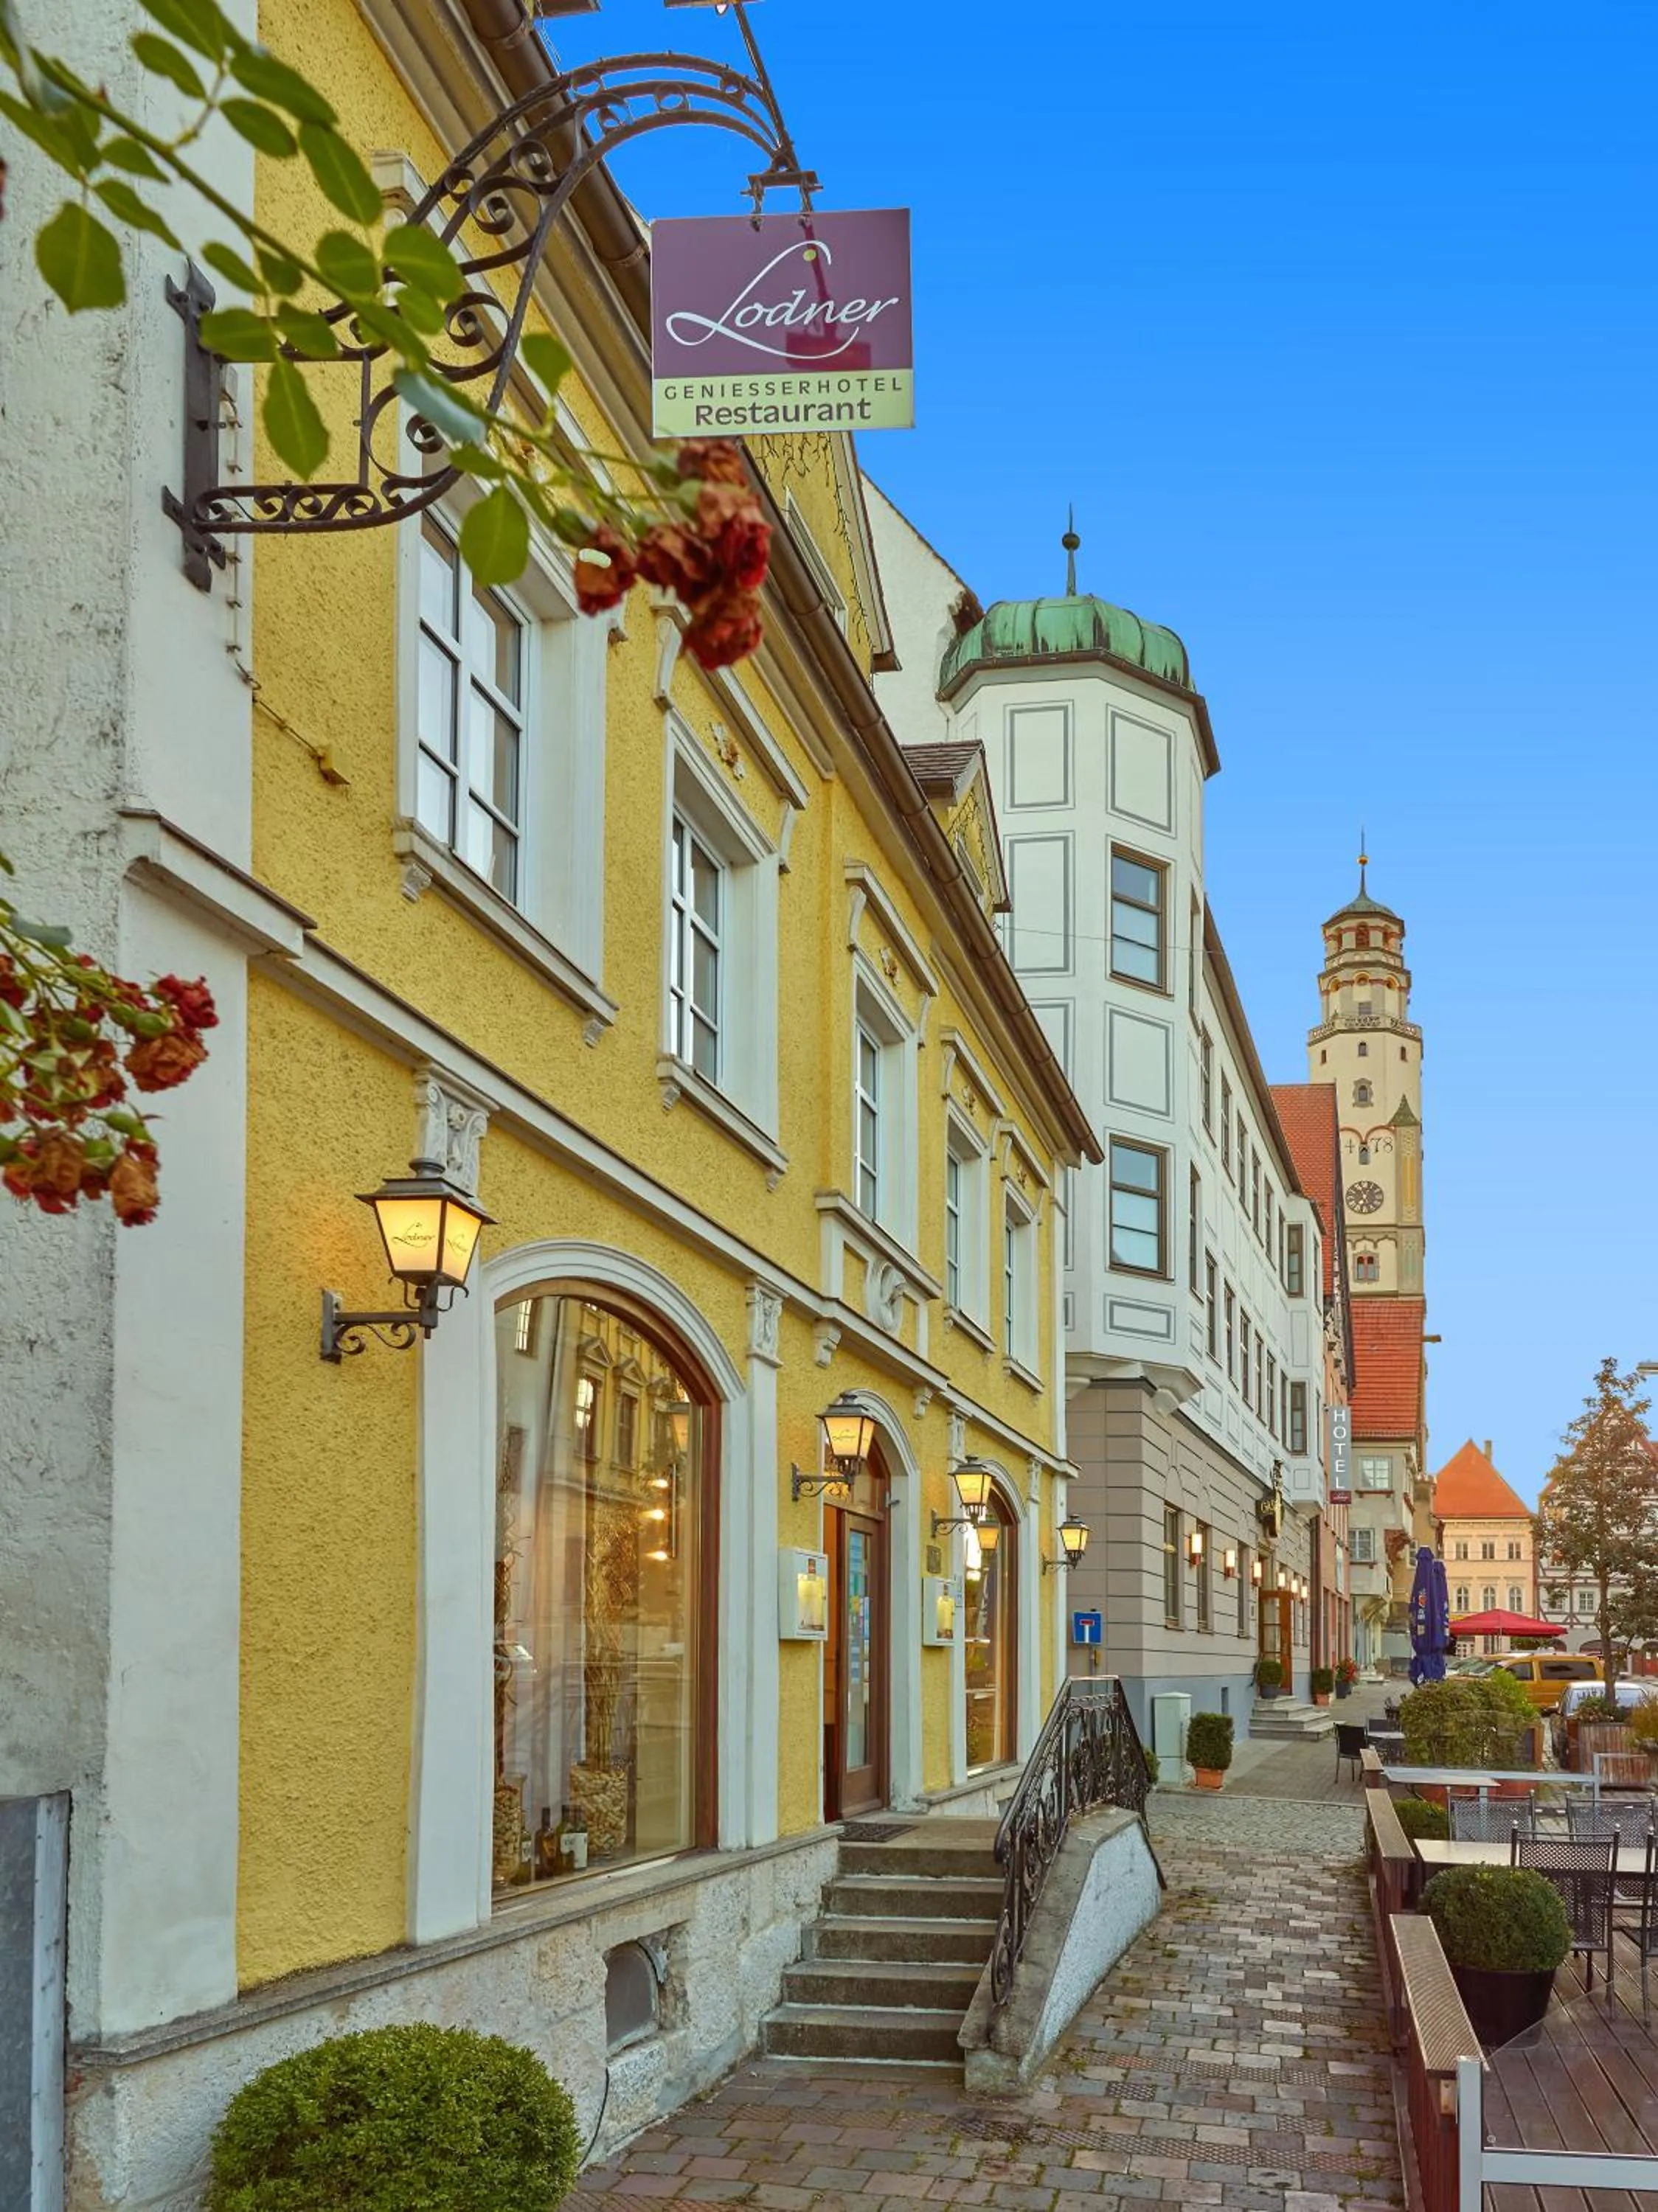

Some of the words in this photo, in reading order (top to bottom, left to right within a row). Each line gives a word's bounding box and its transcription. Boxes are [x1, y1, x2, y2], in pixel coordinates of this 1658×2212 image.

[666, 240, 899, 359] Lodner
[665, 377, 902, 400] GENIESSERHOTEL
[696, 397, 872, 426] Restaurant
[1333, 1409, 1347, 1489] HOTEL
